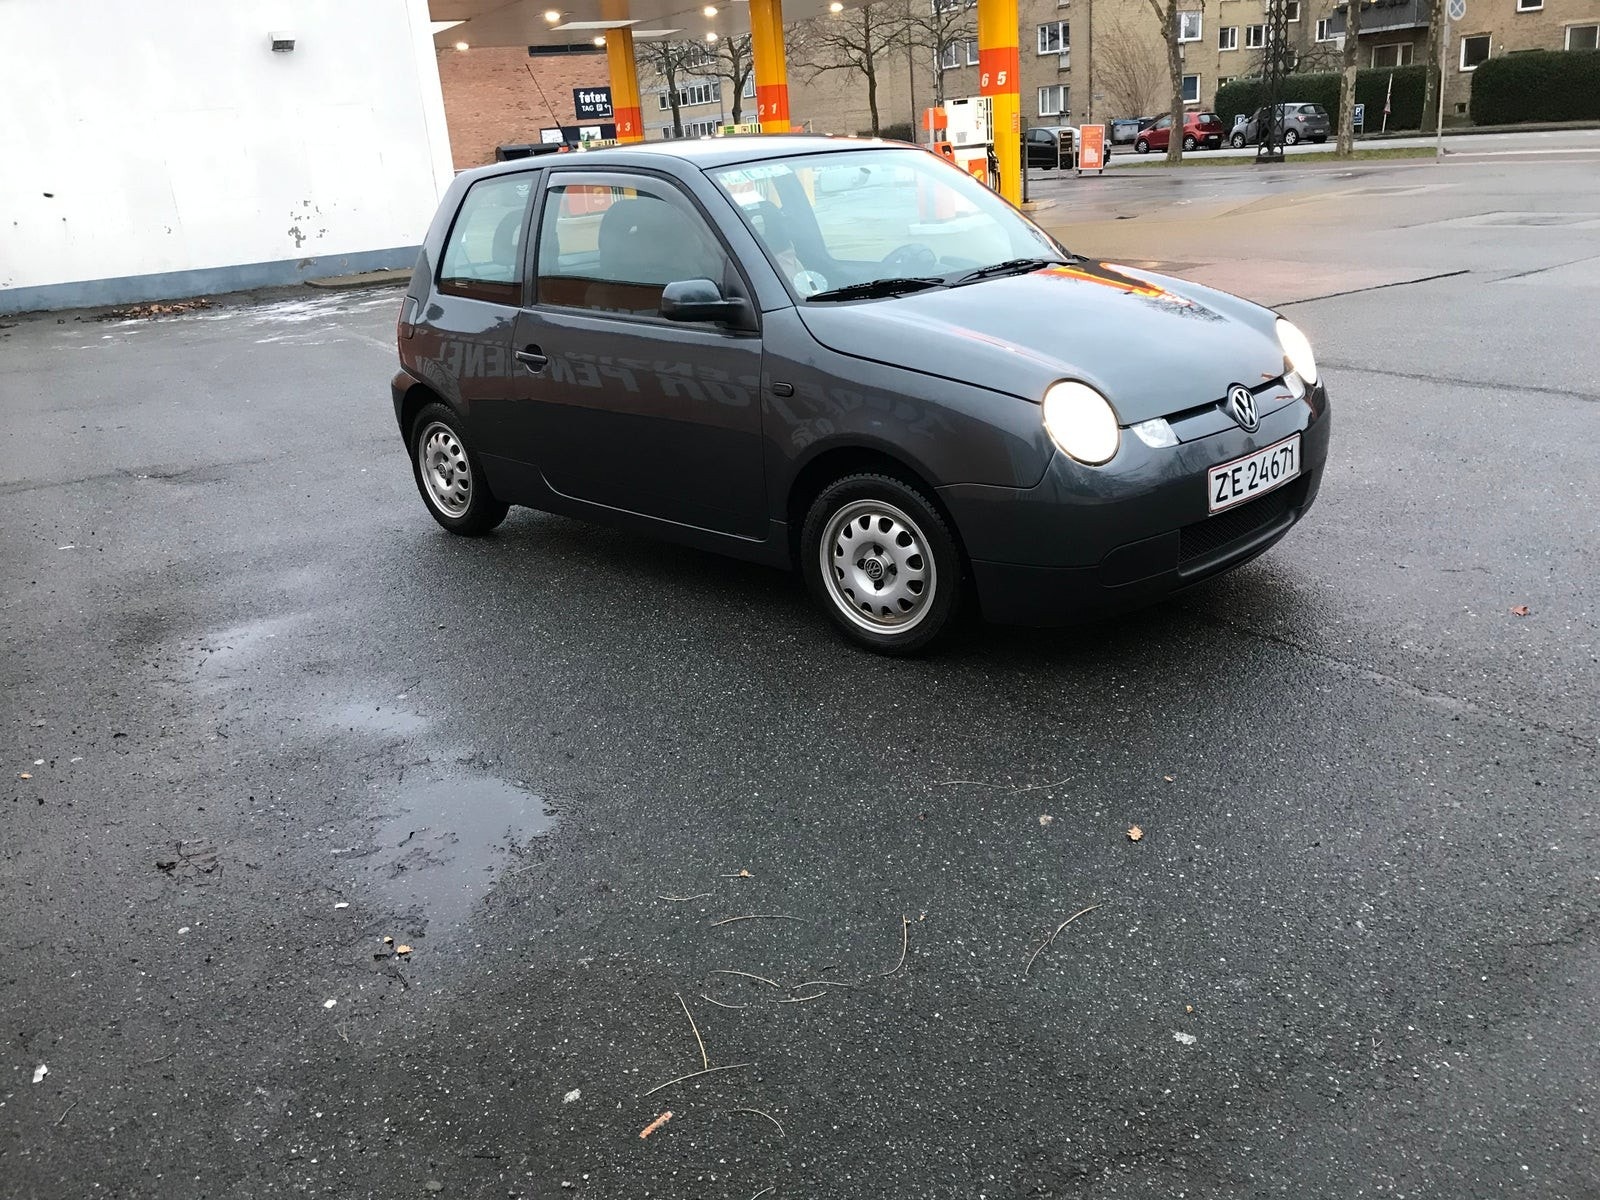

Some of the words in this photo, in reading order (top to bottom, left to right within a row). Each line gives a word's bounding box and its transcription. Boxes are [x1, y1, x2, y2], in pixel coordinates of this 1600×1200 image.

[981, 73, 989, 87] 6
[997, 71, 1007, 85] 5
[760, 104, 765, 115] 2
[772, 103, 777, 114] 1
[625, 122, 631, 131] 3
[1215, 467, 1243, 503] ZE
